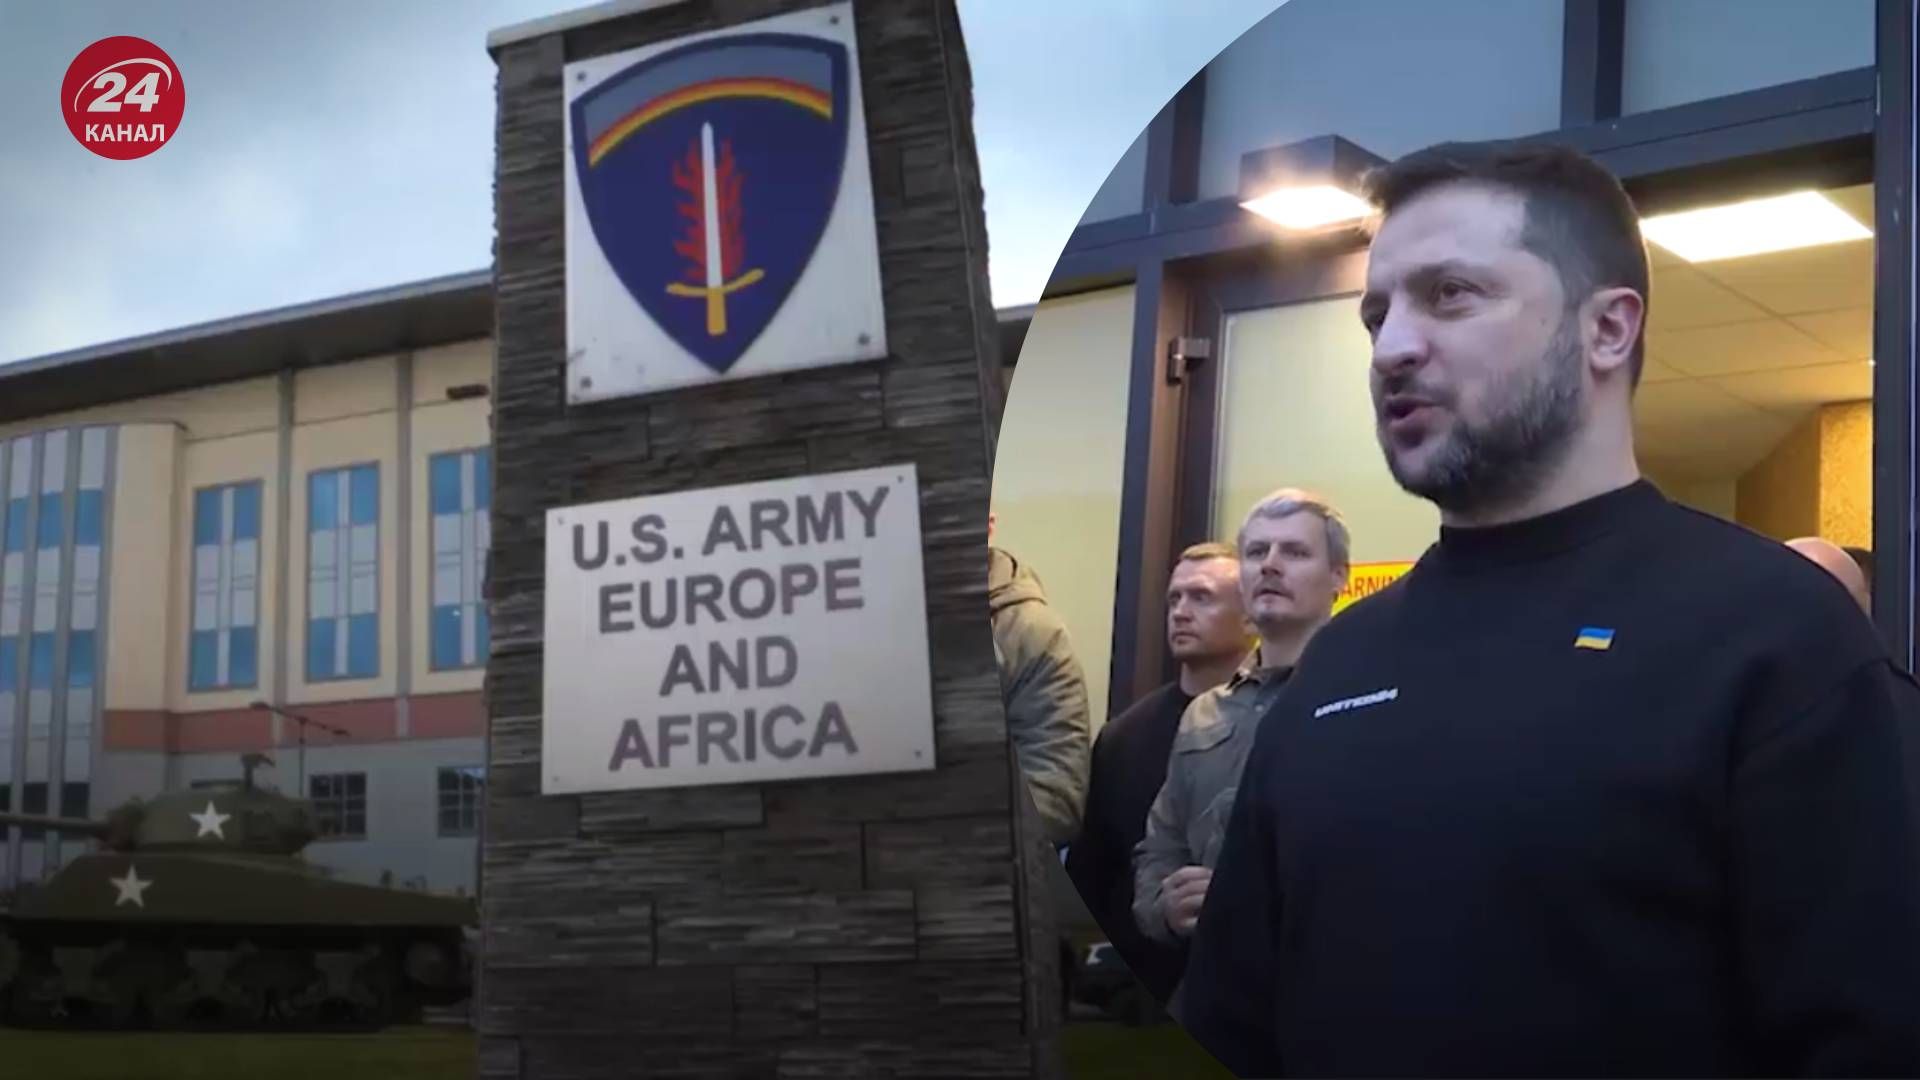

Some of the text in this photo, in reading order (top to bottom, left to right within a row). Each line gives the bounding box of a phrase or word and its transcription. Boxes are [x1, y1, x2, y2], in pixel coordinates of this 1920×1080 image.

[572, 486, 890, 571] U.S. ARMY
[599, 557, 865, 634] EUROPE
[659, 635, 798, 697] AND
[608, 701, 859, 772] AFRICA
